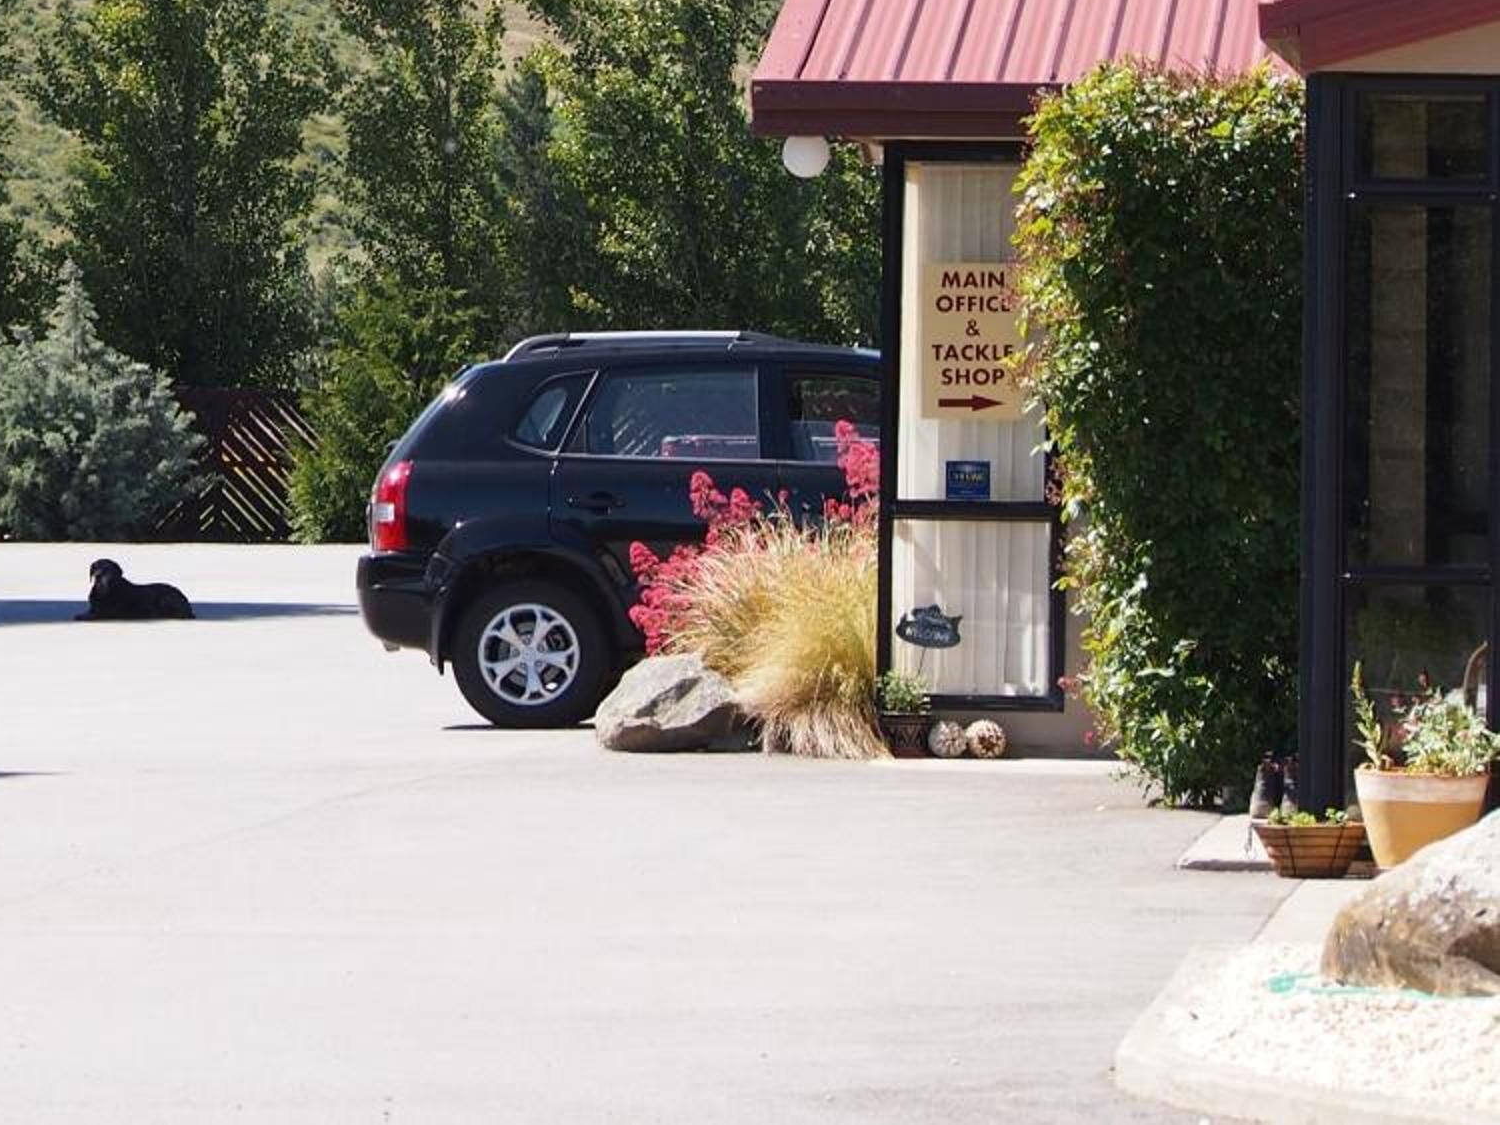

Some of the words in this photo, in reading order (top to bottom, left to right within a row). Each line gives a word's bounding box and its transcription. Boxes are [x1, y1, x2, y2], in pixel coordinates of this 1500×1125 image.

[941, 271, 1005, 288] MAIN
[965, 319, 980, 336] &
[932, 344, 1013, 362] TACKLE
[941, 368, 1005, 385] SHOP
